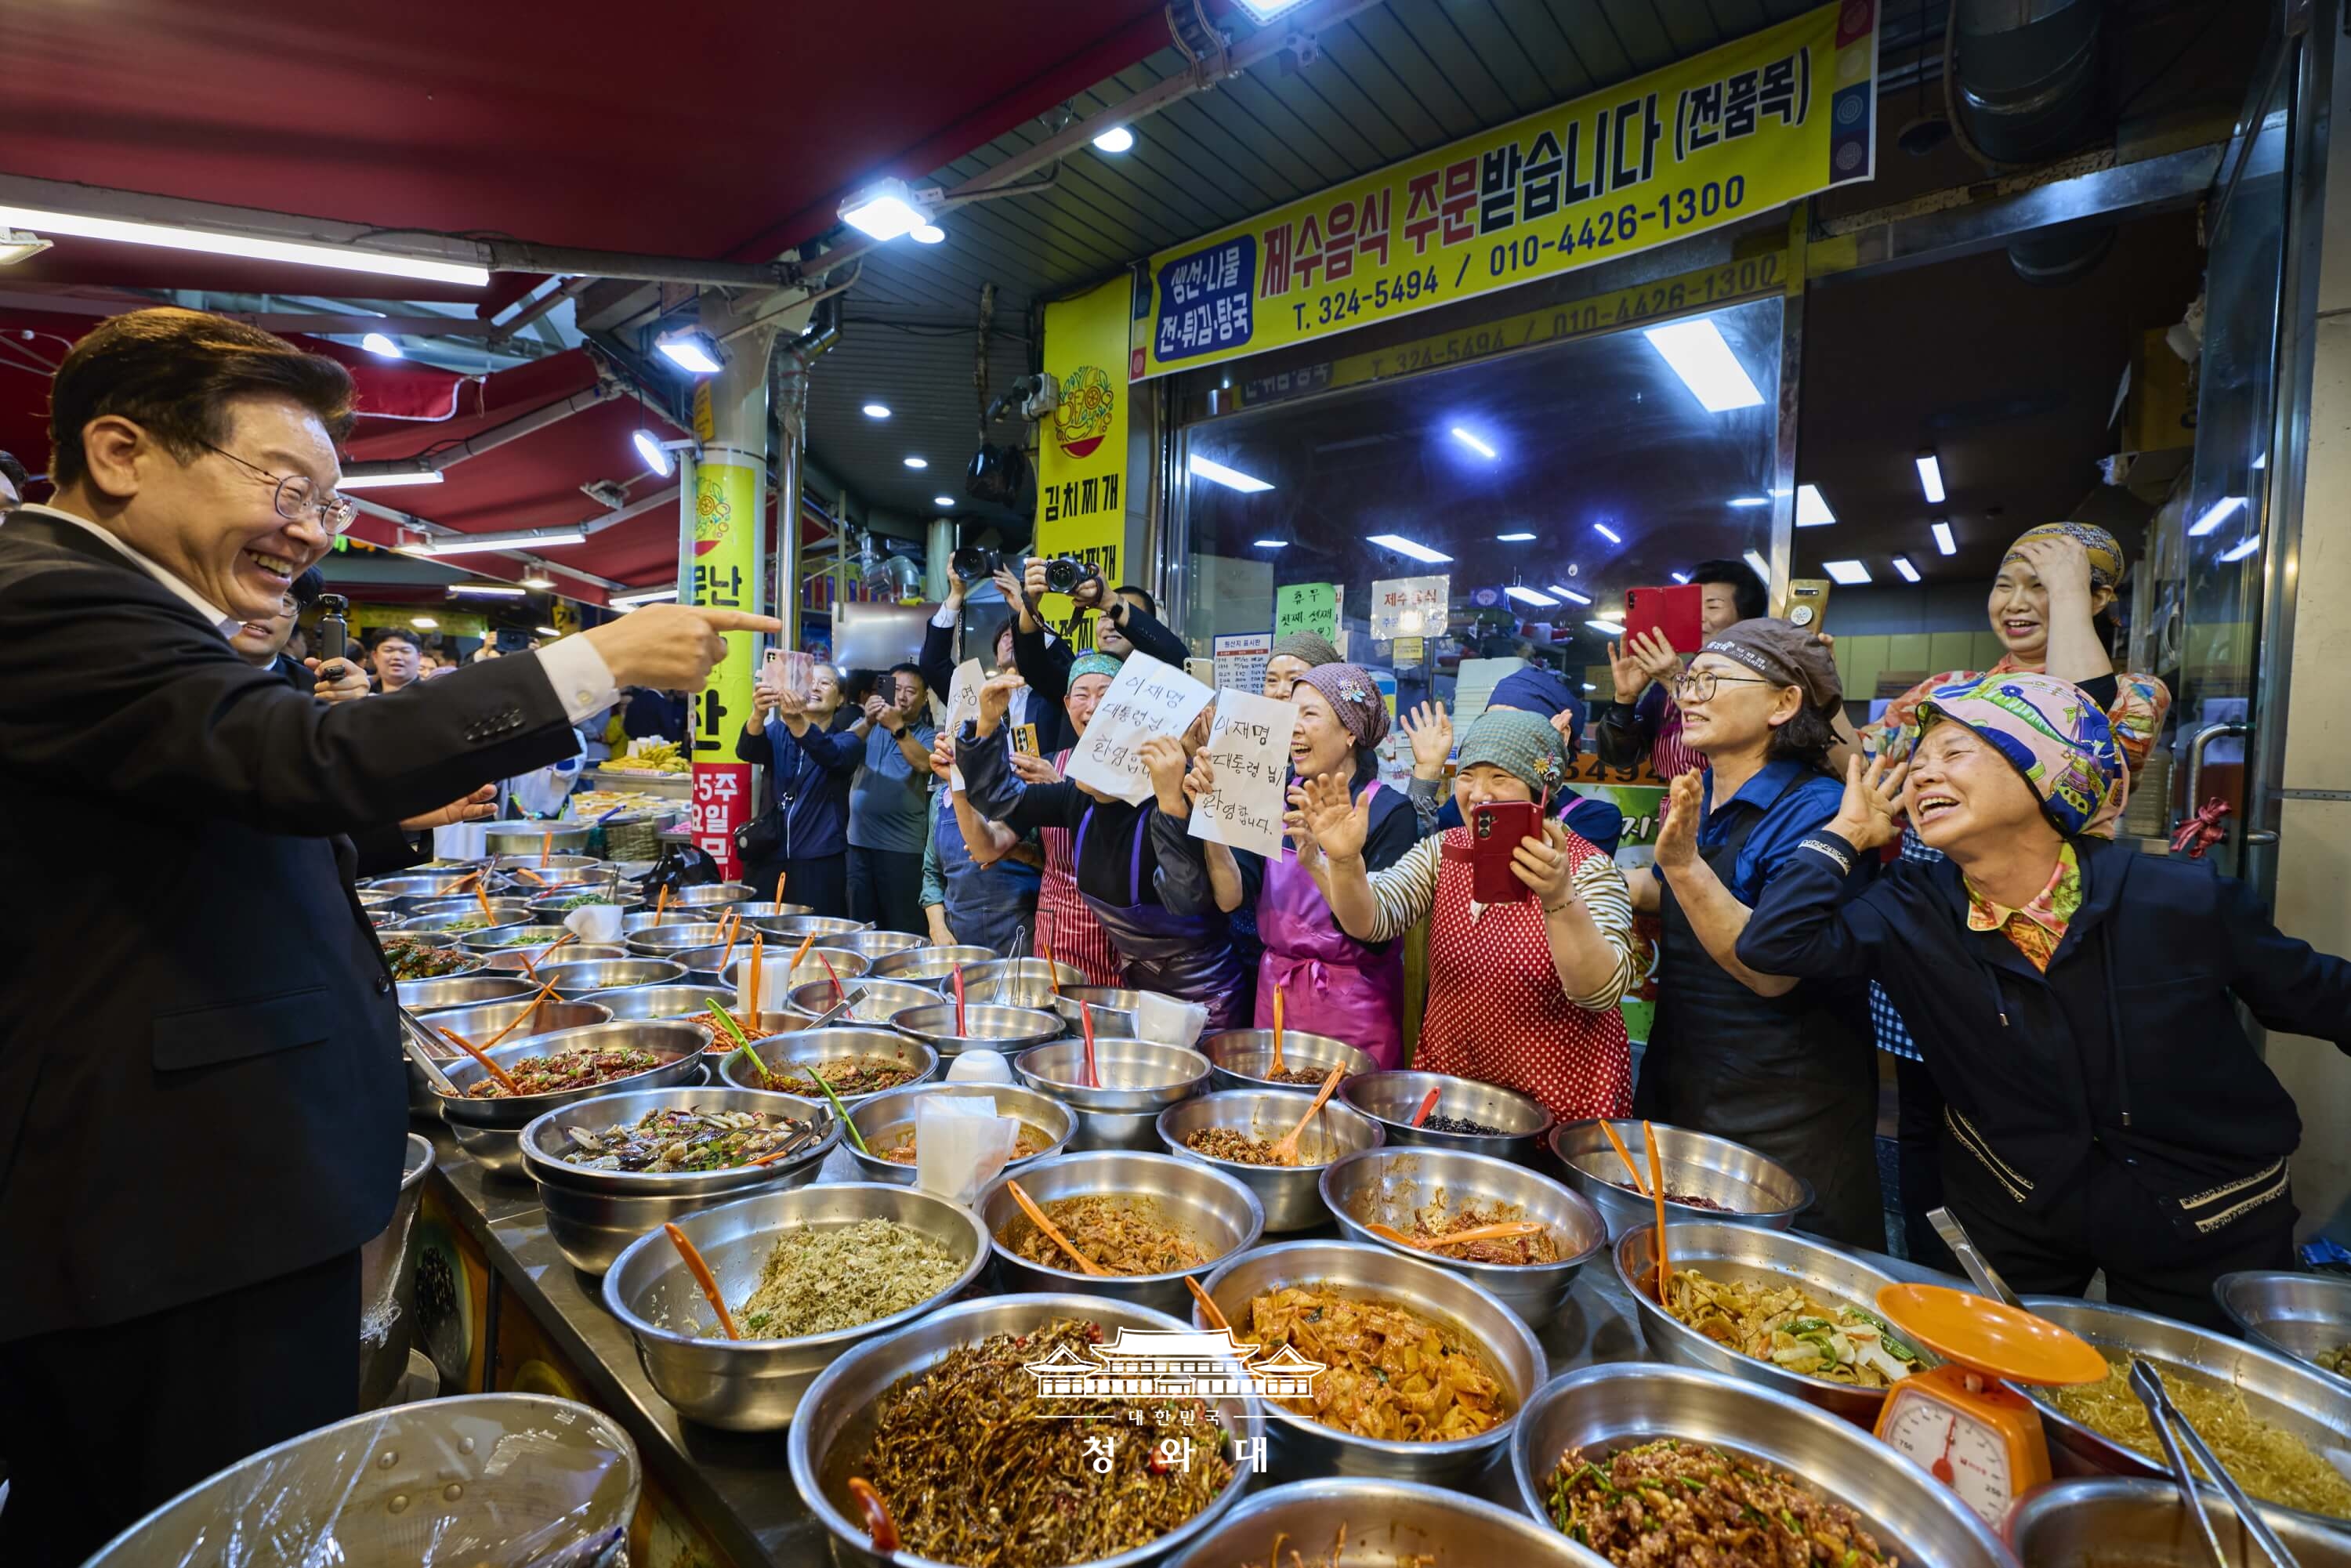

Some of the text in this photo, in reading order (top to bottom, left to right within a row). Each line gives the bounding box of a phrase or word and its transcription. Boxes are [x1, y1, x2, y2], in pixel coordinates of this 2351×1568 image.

[1259, 48, 1809, 299] 제수음식 주문받습니다 (전품목)
[1293, 302, 1311, 331] T.
[1319, 266, 1438, 325] 324-5494
[1491, 175, 1744, 276] 010-4426-1300
[1045, 473, 1118, 523] 김치찌개
[1125, 676, 1186, 708] 이재명
[1215, 715, 1270, 745] 이재명
